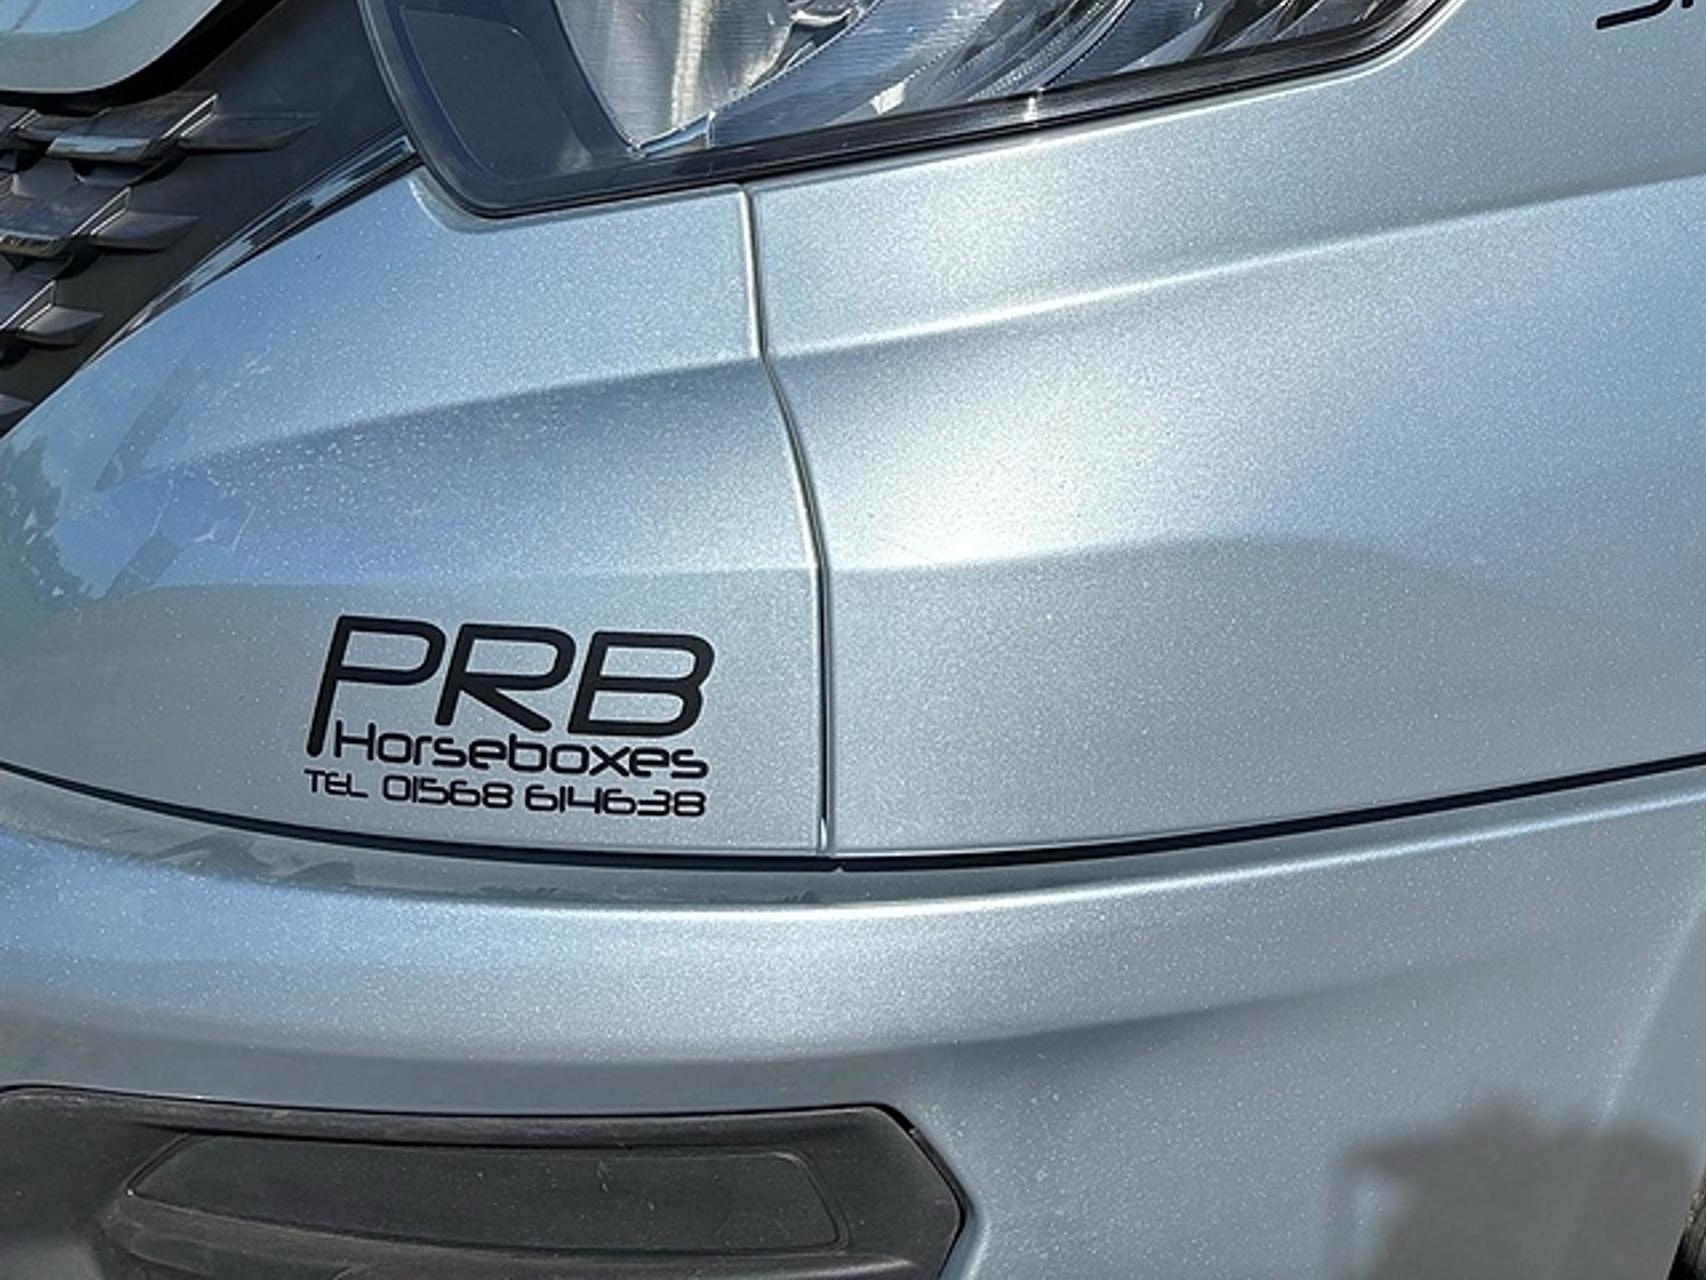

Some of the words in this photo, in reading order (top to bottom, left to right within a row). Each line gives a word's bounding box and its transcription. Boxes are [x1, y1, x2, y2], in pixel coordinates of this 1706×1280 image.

[307, 615, 716, 758] PRB
[333, 719, 710, 780] Horseboxes
[304, 767, 369, 799] TEL
[382, 773, 514, 810] 01568
[524, 783, 707, 818] 614638
